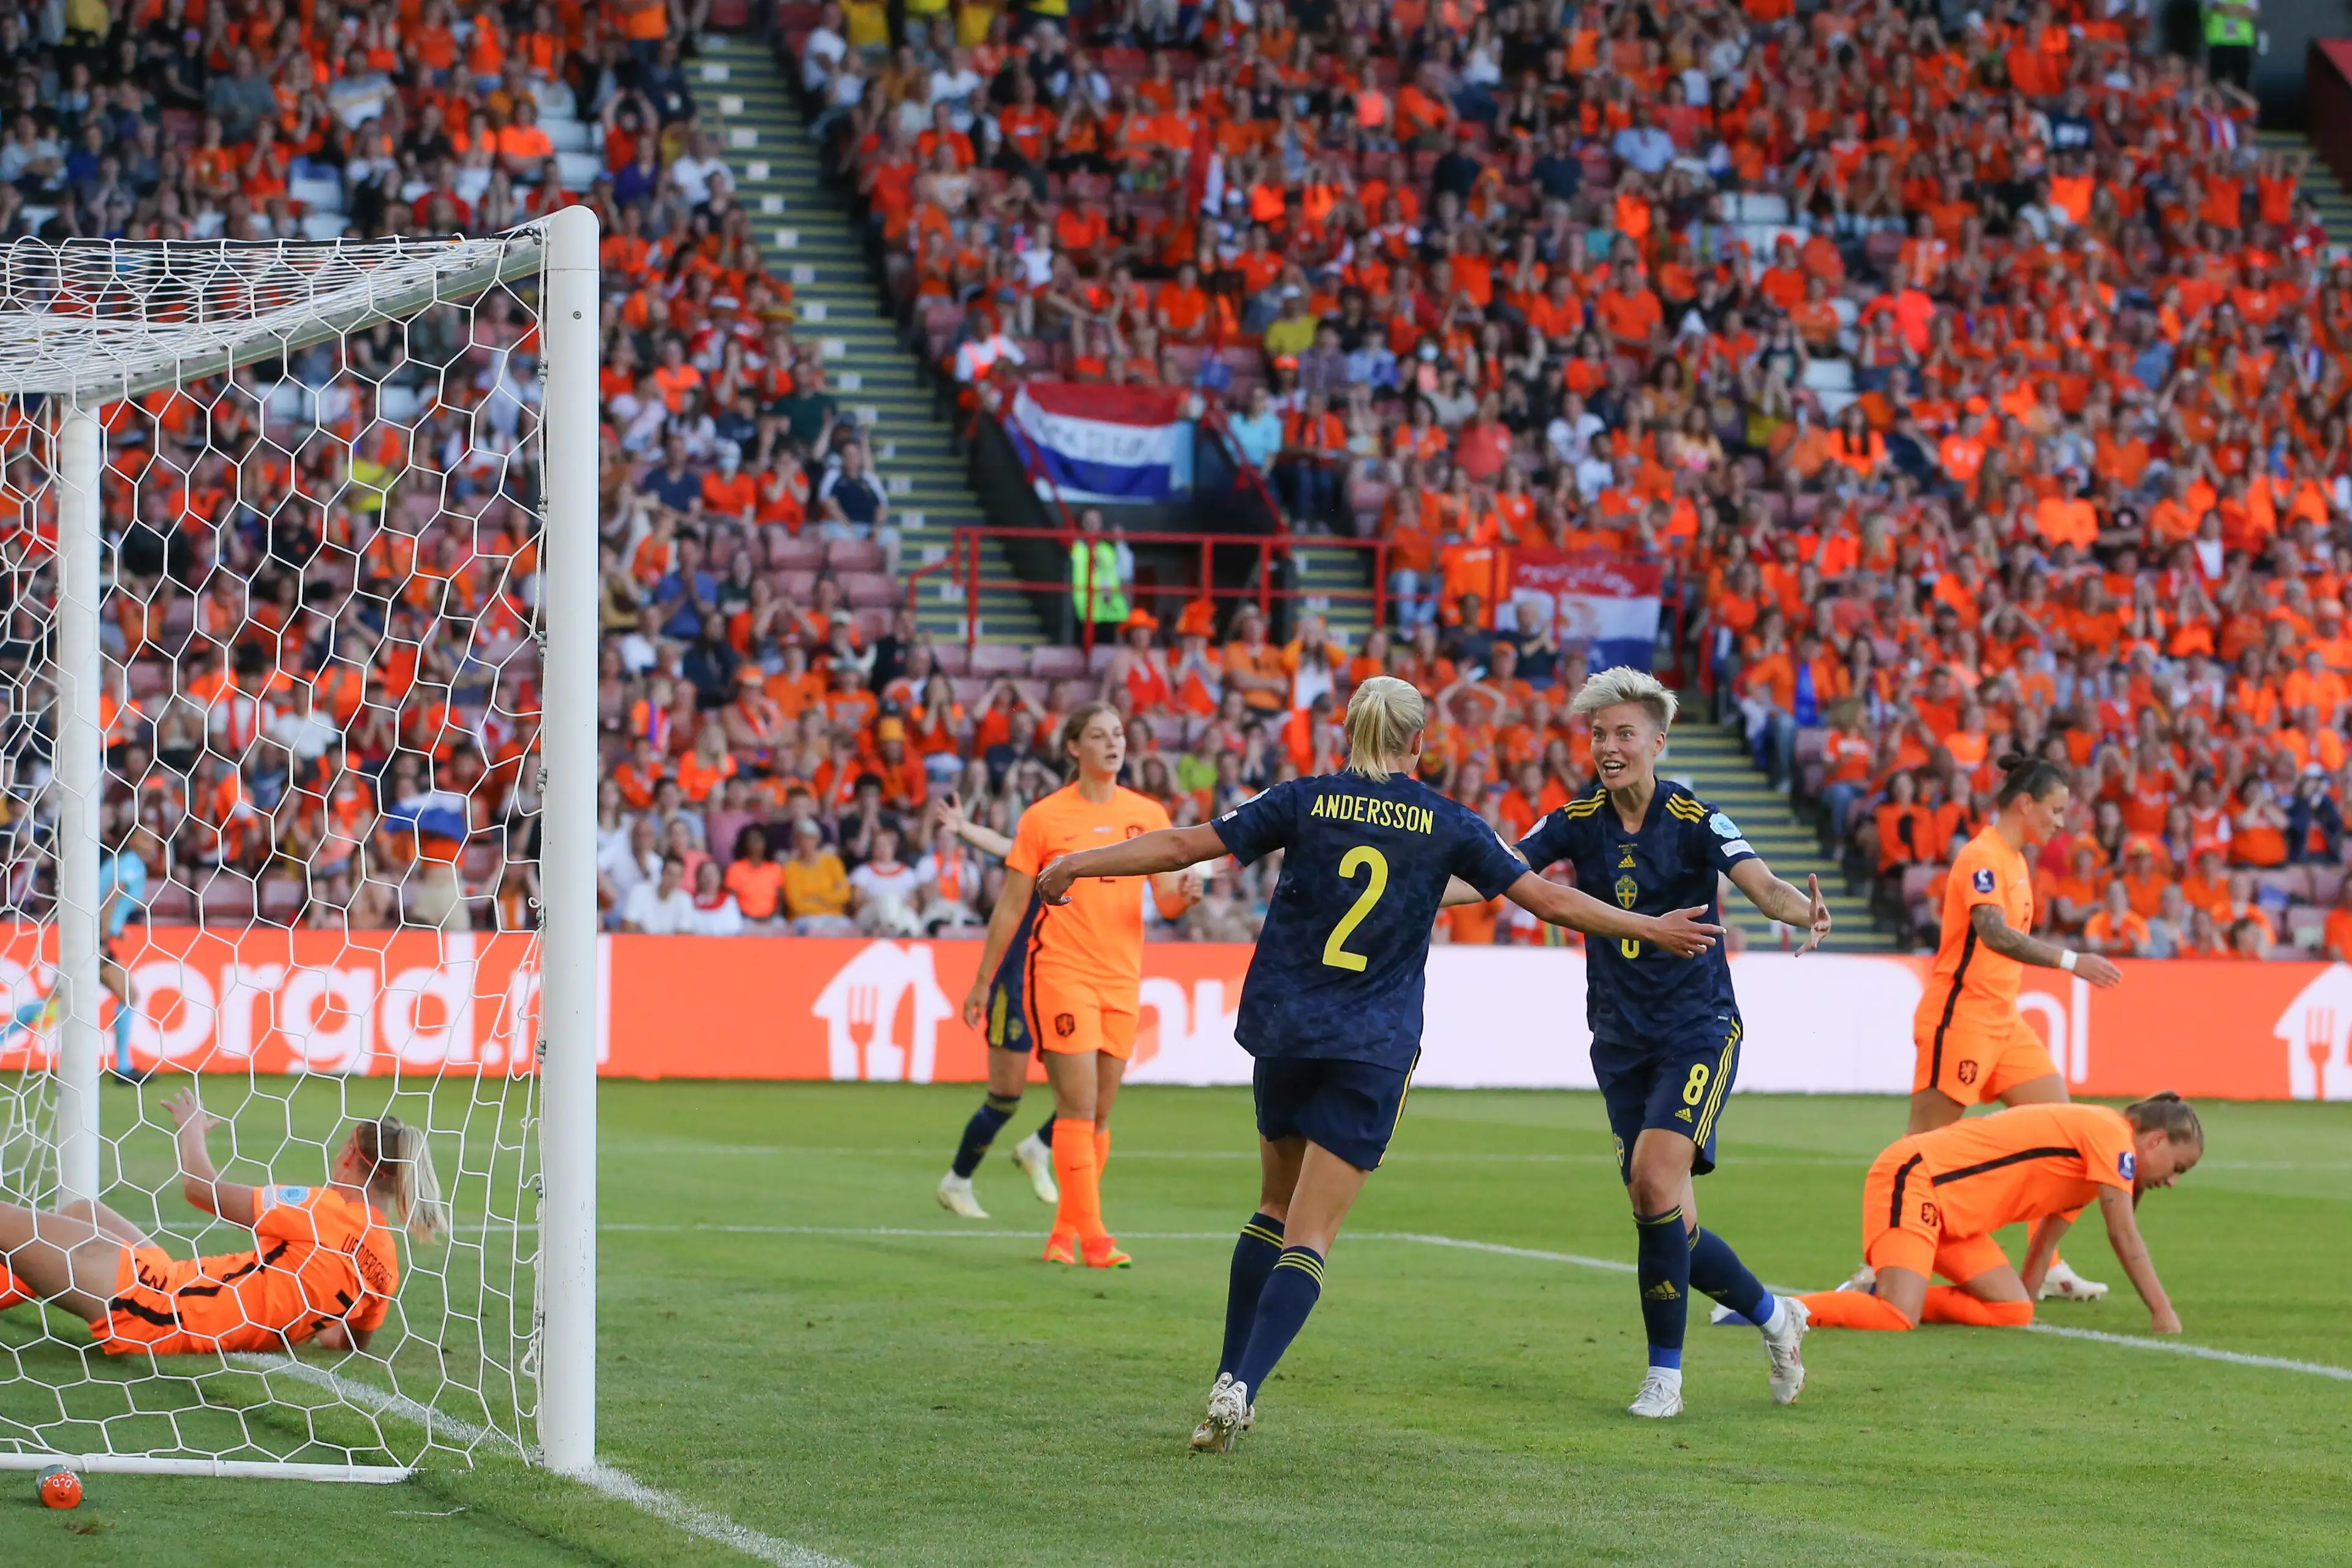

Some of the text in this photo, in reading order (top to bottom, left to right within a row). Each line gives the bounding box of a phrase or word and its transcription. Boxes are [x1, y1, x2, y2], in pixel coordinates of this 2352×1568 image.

[1310, 794, 1434, 835] ANDERSSON
[1322, 845, 1389, 972] 2
[1683, 1063, 1710, 1106] 8
